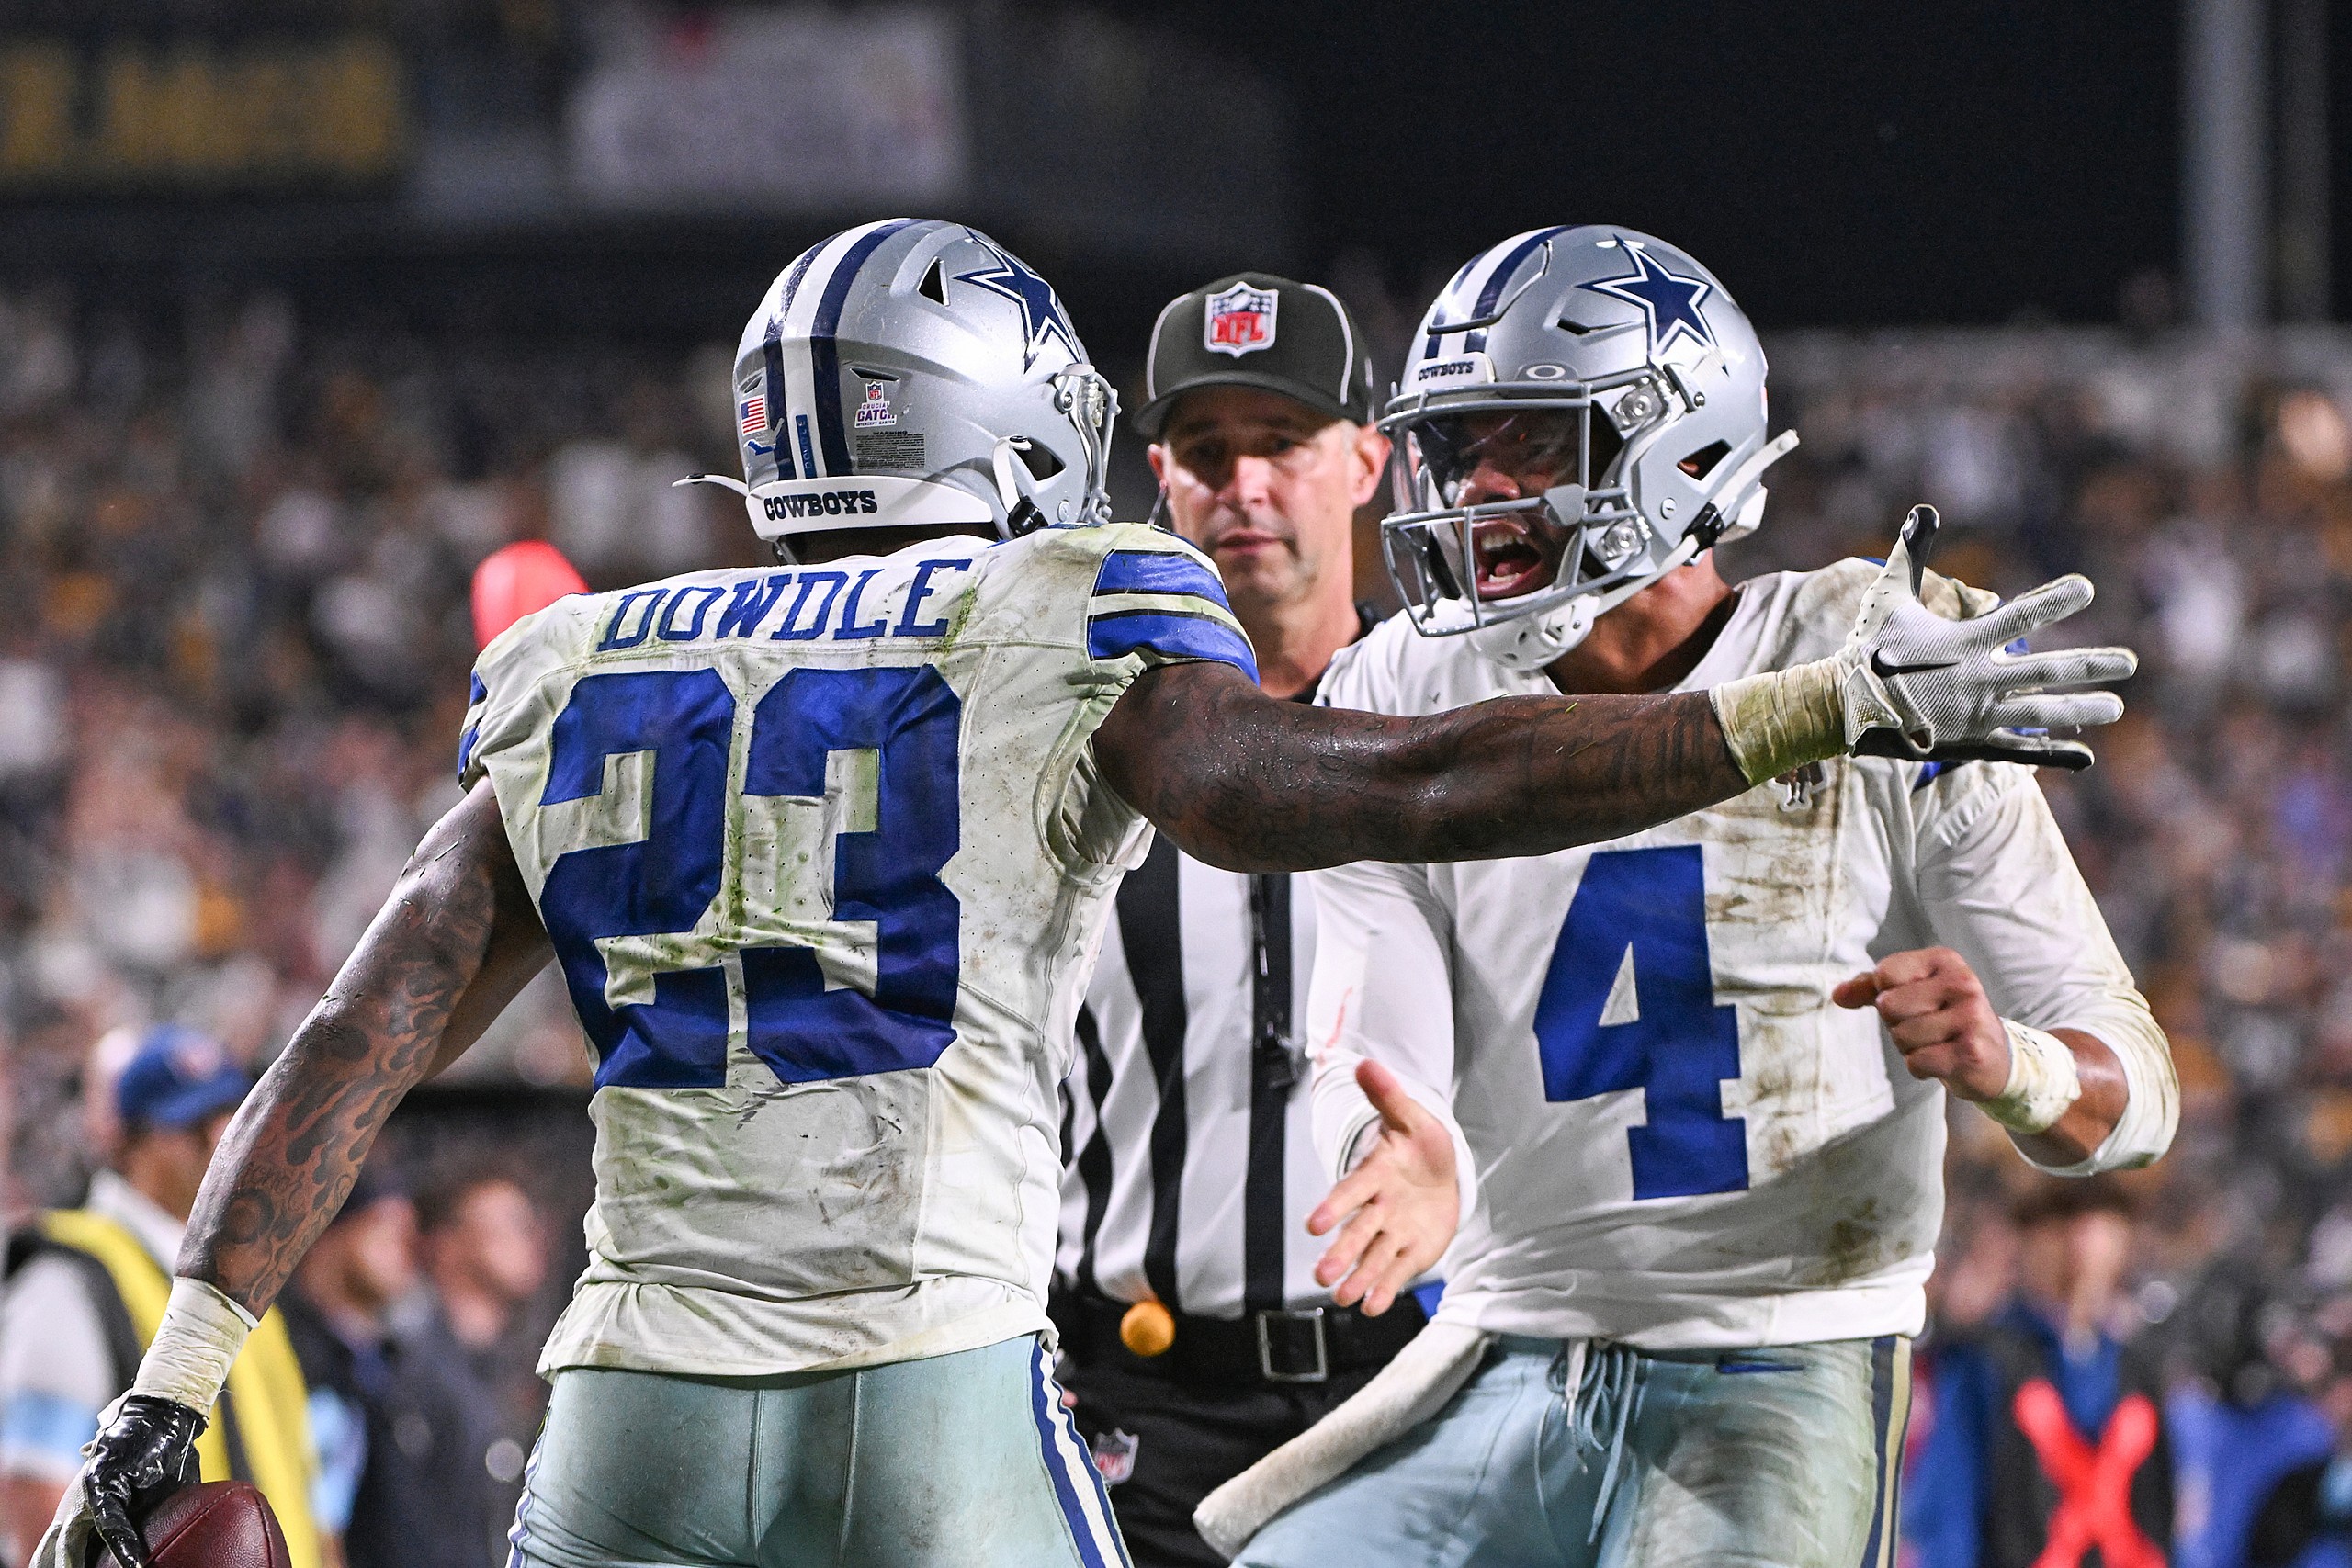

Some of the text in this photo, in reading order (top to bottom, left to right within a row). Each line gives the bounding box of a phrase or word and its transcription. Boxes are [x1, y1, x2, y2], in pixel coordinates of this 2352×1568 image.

[1212, 312, 1264, 344] NFL
[1419, 361, 1474, 381] COWBOYS
[763, 490, 878, 521] COWBOYS
[595, 558, 973, 652] DOWDLE
[539, 664, 961, 1093] 23
[1532, 843, 1749, 1200] 4
